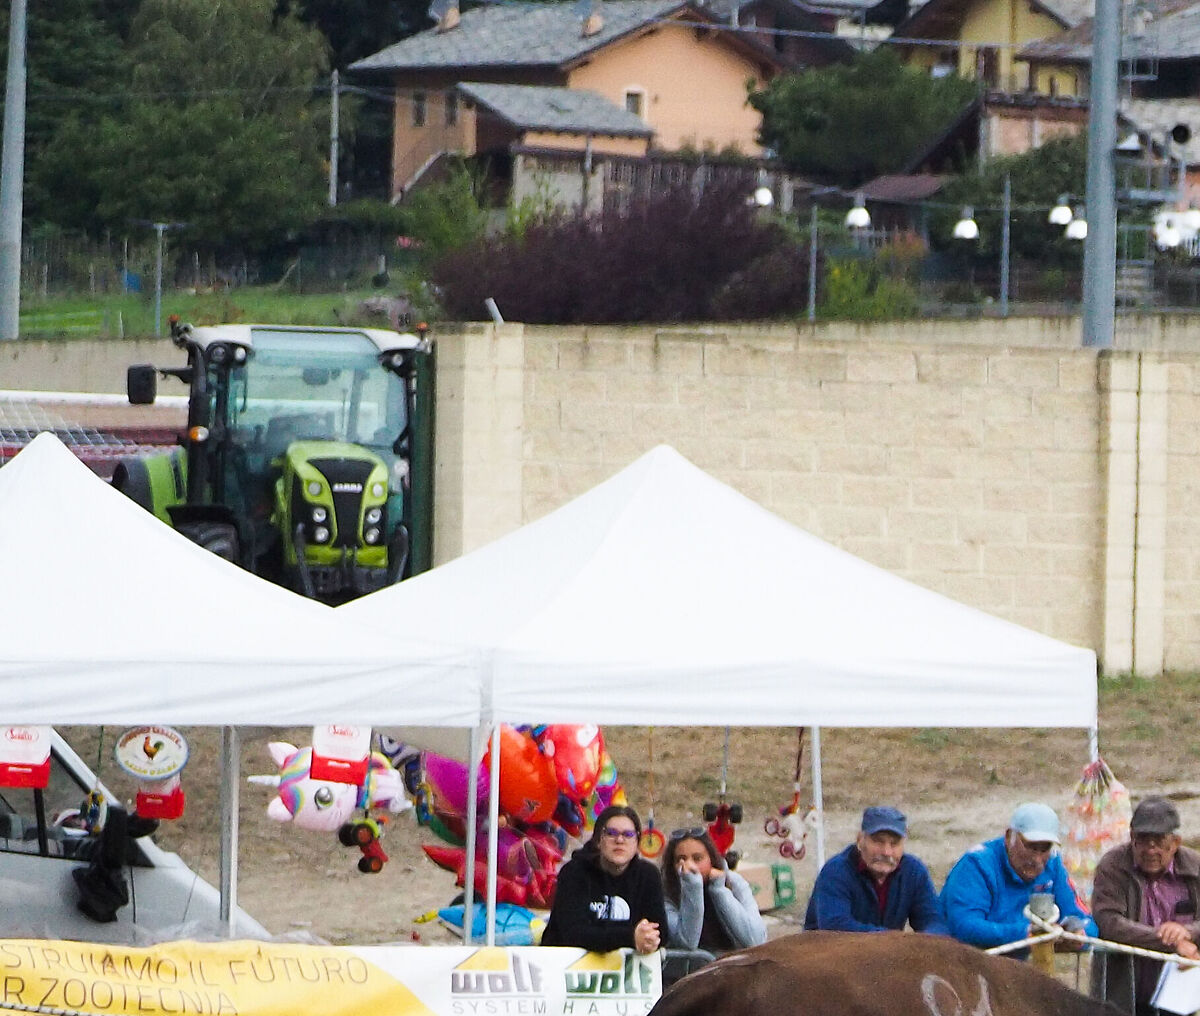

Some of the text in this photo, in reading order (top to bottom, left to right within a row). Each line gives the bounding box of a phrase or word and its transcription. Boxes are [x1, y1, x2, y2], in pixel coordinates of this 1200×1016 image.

[0, 944, 369, 986] STRUIAMO IL FUTURO
[451, 952, 546, 994] wolf
[565, 952, 652, 994] wolf
[40, 977, 239, 1016] ZOOTECNIA
[452, 1001, 547, 1016] SYSTEM
